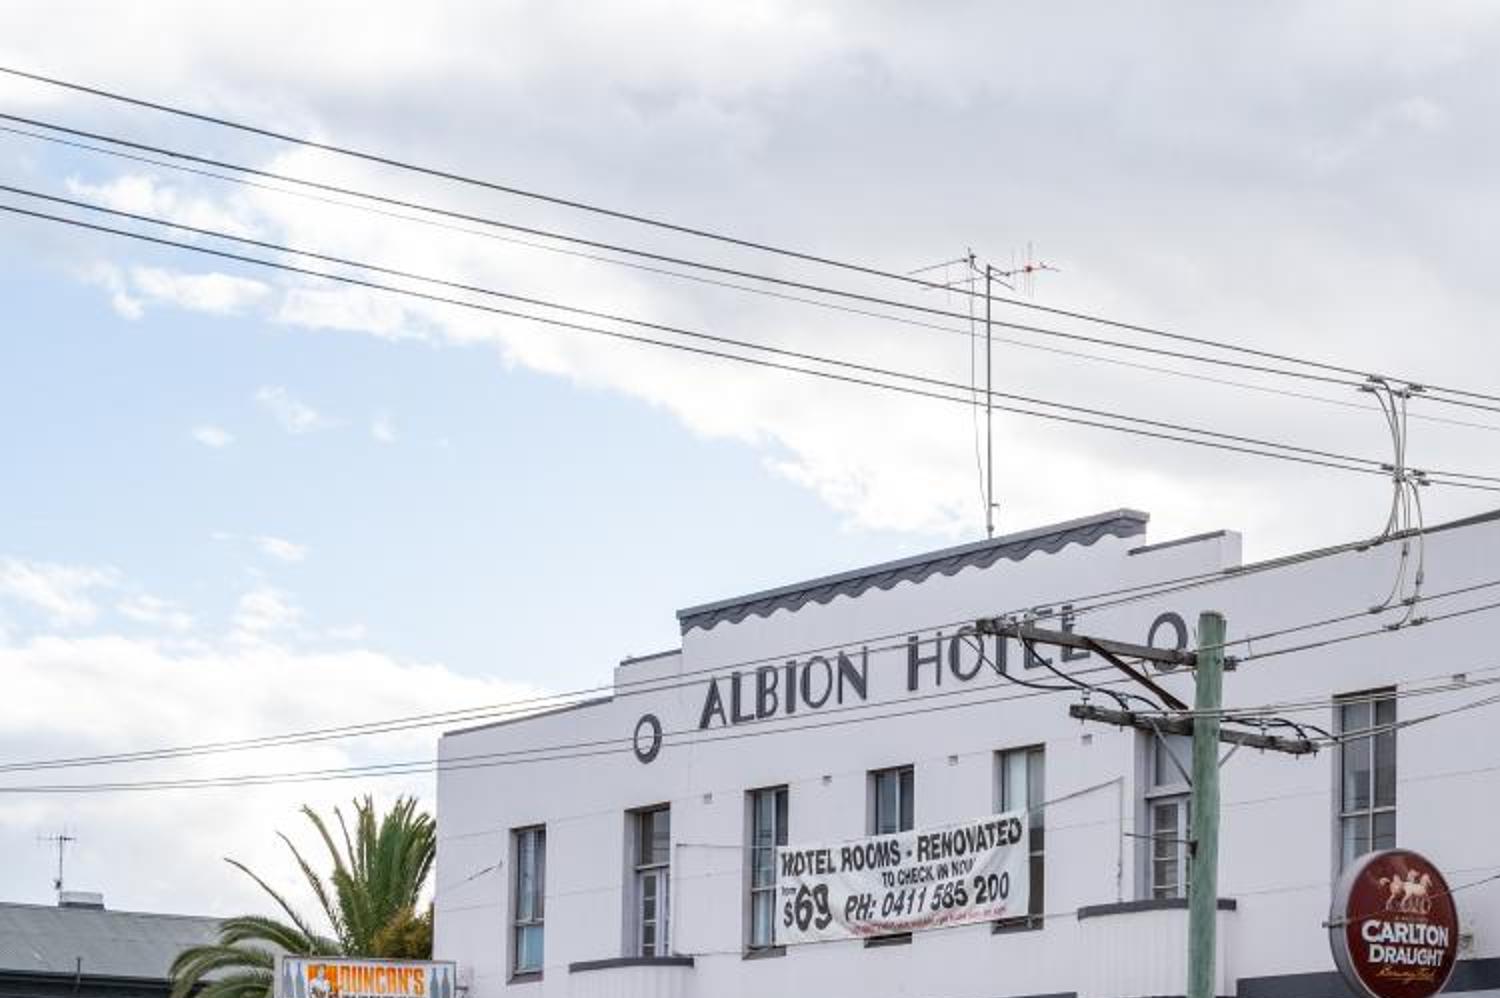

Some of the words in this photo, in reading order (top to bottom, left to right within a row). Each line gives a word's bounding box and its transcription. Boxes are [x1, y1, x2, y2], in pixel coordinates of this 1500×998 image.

[700, 646, 868, 729] ALBION
[907, 604, 1091, 691] HOTEL
[841, 840, 901, 871] ROOMS
[917, 817, 1023, 862] RENOVATED
[845, 893, 876, 922] PH:
[882, 887, 925, 917] 0411
[973, 872, 1010, 904] 200
[882, 870, 895, 888] TO
[898, 865, 934, 886] CHECK
[937, 863, 949, 881] IN
[784, 883, 832, 931] $69
[1362, 919, 1449, 947] CARLTON
[1368, 944, 1444, 967] DRAUGHT
